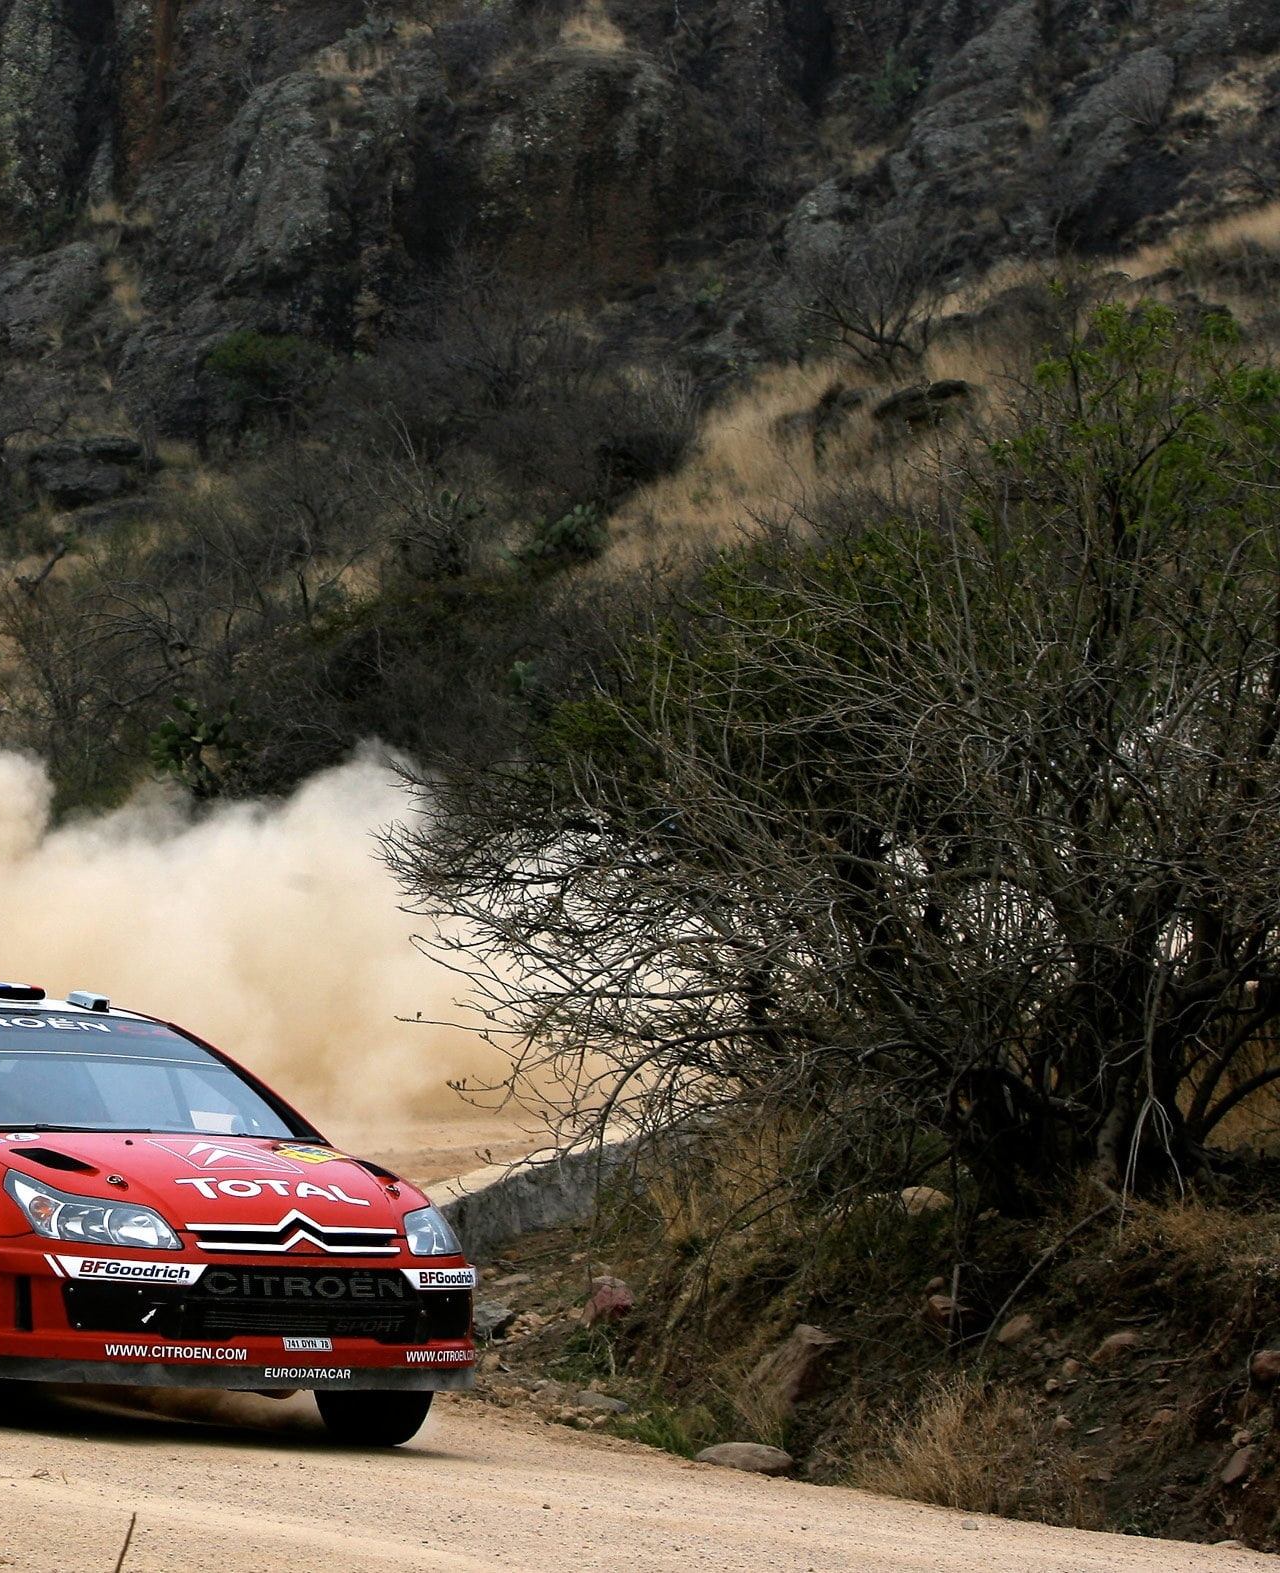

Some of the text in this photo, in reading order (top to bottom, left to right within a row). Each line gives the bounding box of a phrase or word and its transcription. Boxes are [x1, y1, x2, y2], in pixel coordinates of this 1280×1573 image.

[174, 1177, 370, 1206] TOTAL
[79, 1260, 191, 1279] BFGoodrich
[419, 1271, 474, 1284] BFGoodrich
[203, 1271, 405, 1299] CITROËN
[334, 1319, 406, 1333] SPORT
[105, 1343, 247, 1361] WWW.CITROEN.COM
[264, 1367, 352, 1379] EURODATACAR
